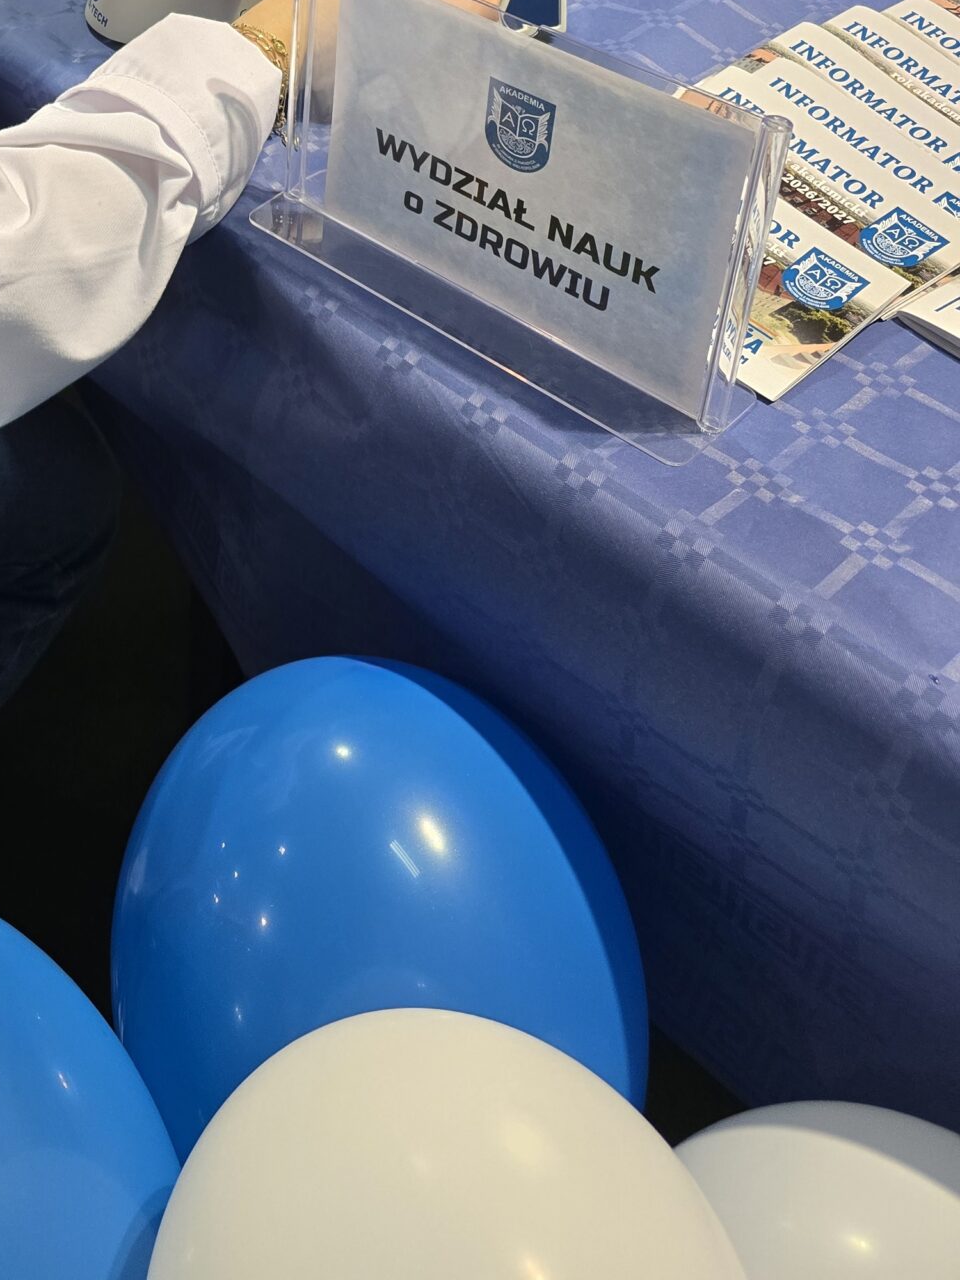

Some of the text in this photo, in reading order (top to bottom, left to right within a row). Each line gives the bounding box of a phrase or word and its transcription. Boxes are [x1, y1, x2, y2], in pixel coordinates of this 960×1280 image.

[900, 10, 960, 58] INFO
[500, 85, 545, 111] AKADEMIA
[789, 39, 949, 154] INFORMATOR
[768, 76, 934, 195] INFORMATOR
[376, 127, 660, 294] WYDZIAŁ NAUK
[781, 172, 856, 225] 2026/2027
[790, 162, 869, 218] akademicki
[899, 213, 939, 241] AKADEMIA
[433, 200, 610, 312] ZDROWIU
[817, 254, 859, 282] AKADEMIA
